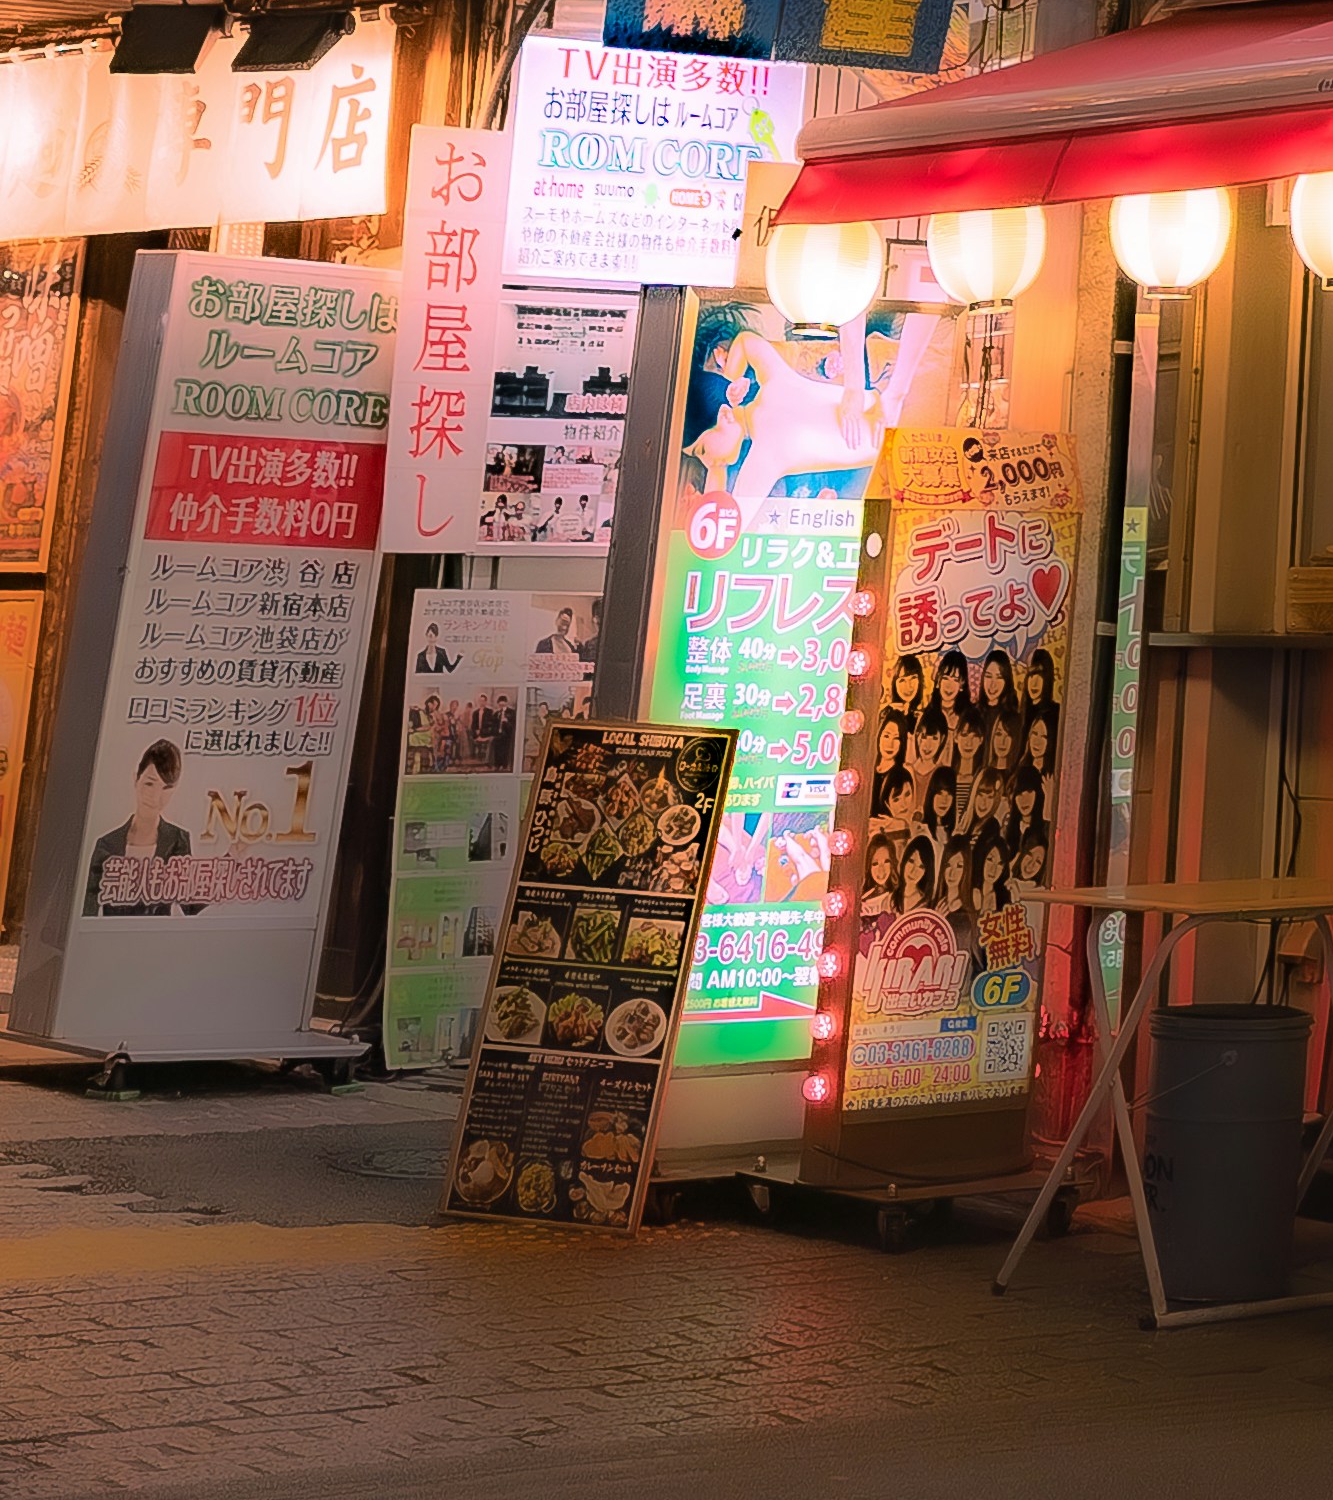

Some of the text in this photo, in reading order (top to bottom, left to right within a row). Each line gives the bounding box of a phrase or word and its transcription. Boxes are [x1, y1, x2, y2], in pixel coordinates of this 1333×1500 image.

[558, 47, 770, 97] TV出演多数!!
[544, 86, 739, 131] お部屋探しは ルームコア
[538, 129, 647, 174] ROOM
[595, 182, 635, 198] suumo
[189, 278, 400, 333] お部屋探しは
[201, 334, 378, 377] ルームコア
[410, 141, 485, 538] お部屋探し
[173, 381, 390, 427] ROOM CORE
[189, 445, 358, 490] TV出演多数!!
[980, 456, 1064, 494] 2,000円
[1004, 485, 1051, 506] もらえます!
[169, 493, 358, 539] 仲介手数料0円
[689, 502, 736, 551] 6F
[789, 507, 855, 529] English
[741, 536, 860, 569] リラク&エ
[910, 512, 1046, 583] デートに
[145, 589, 350, 620] ルームコア新宿本店
[684, 570, 857, 636] リフレス
[898, 582, 1028, 648] 誘ってよ
[140, 622, 347, 652] ルームコア池袋店が
[687, 636, 777, 665] 整体 40分
[134, 658, 343, 687] おすすめの賃貸不動産
[127, 693, 338, 726] 口コミランキング1位
[681, 683, 772, 712] 足裏 30分
[185, 729, 331, 754] に選ばれました!!
[602, 731, 685, 750] LOCAL SHIBUYA
[202, 759, 317, 846] No.1
[695, 792, 715, 815] 2F
[99, 855, 313, 903] 芸能人もお部屋探しされてます
[888, 918, 935, 957] community
[979, 904, 1026, 942] 女性
[983, 974, 1022, 1005] 6F
[867, 1037, 972, 1063] 03-3461-8288
[934, 1064, 971, 1086] 24:00
